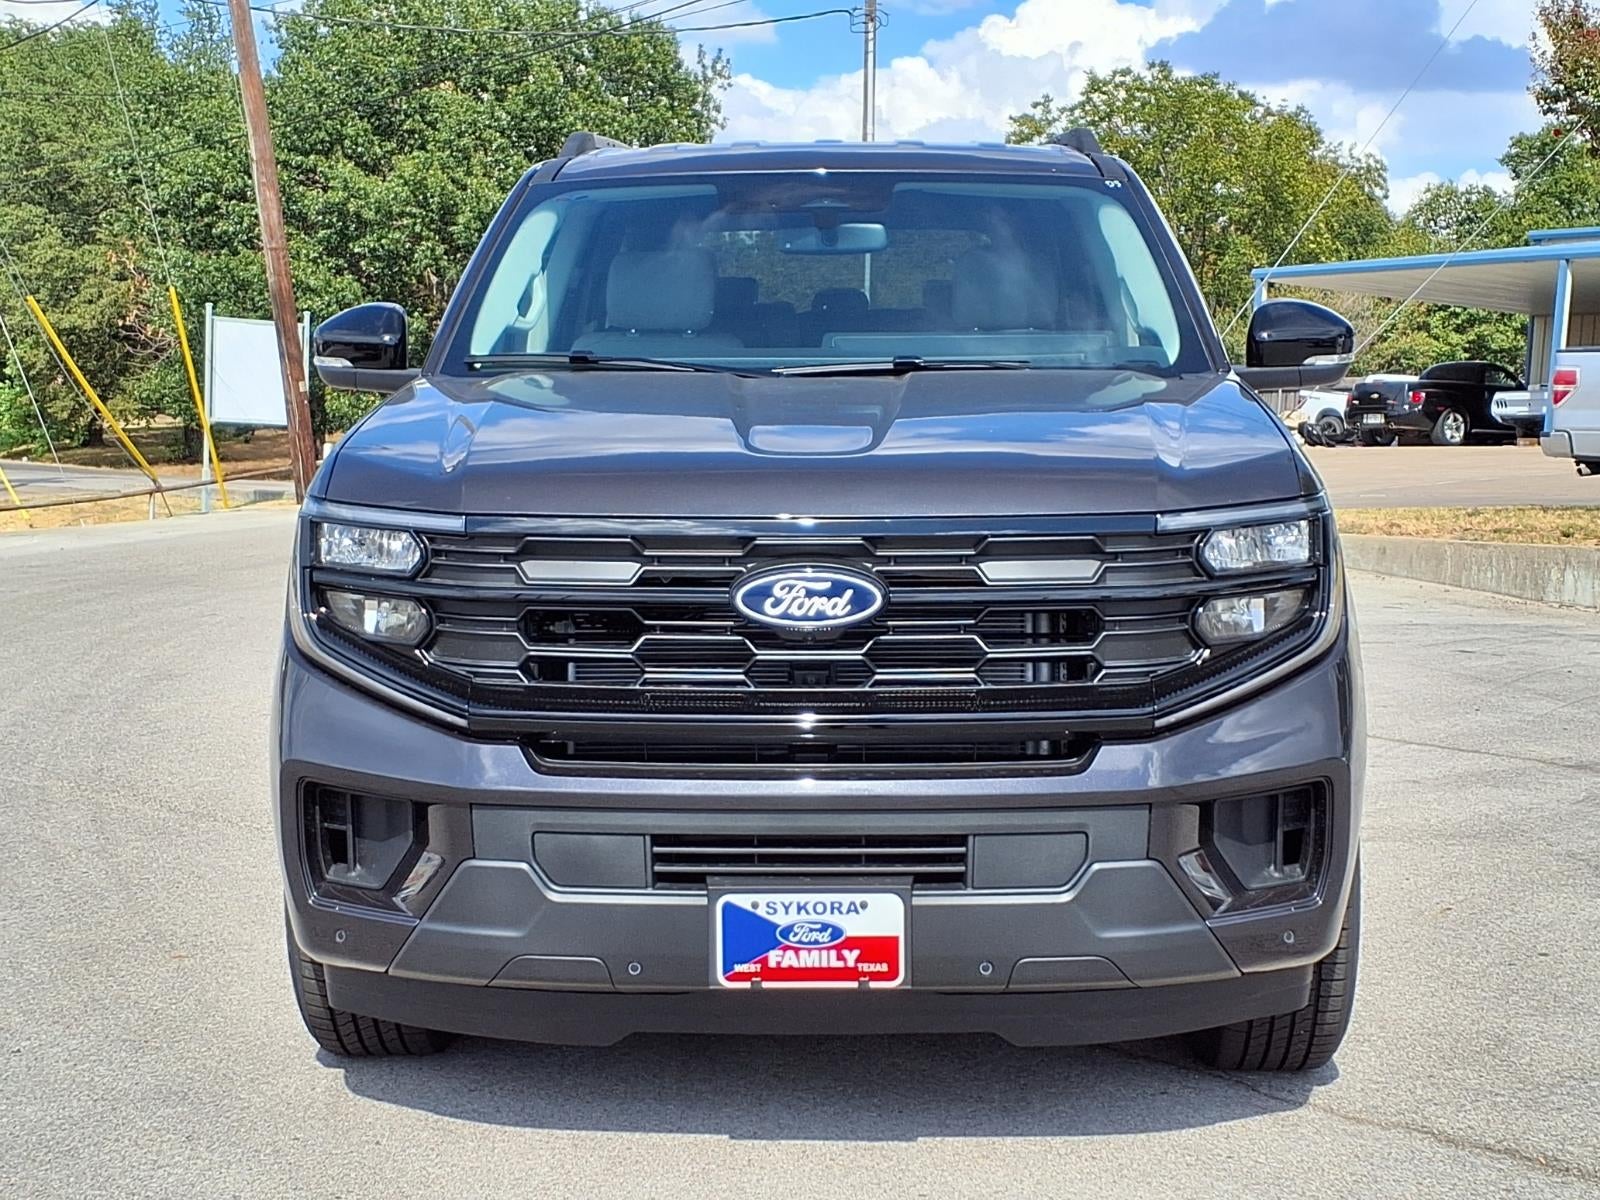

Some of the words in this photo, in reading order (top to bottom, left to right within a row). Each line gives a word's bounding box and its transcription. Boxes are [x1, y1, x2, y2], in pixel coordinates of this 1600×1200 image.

[763, 579, 854, 616] Ford
[765, 901, 861, 916] SYKORA
[788, 922, 832, 943] Ford
[767, 949, 861, 968] FAMILY
[857, 962, 889, 972] TEXAS
[734, 963, 762, 973] WEST
